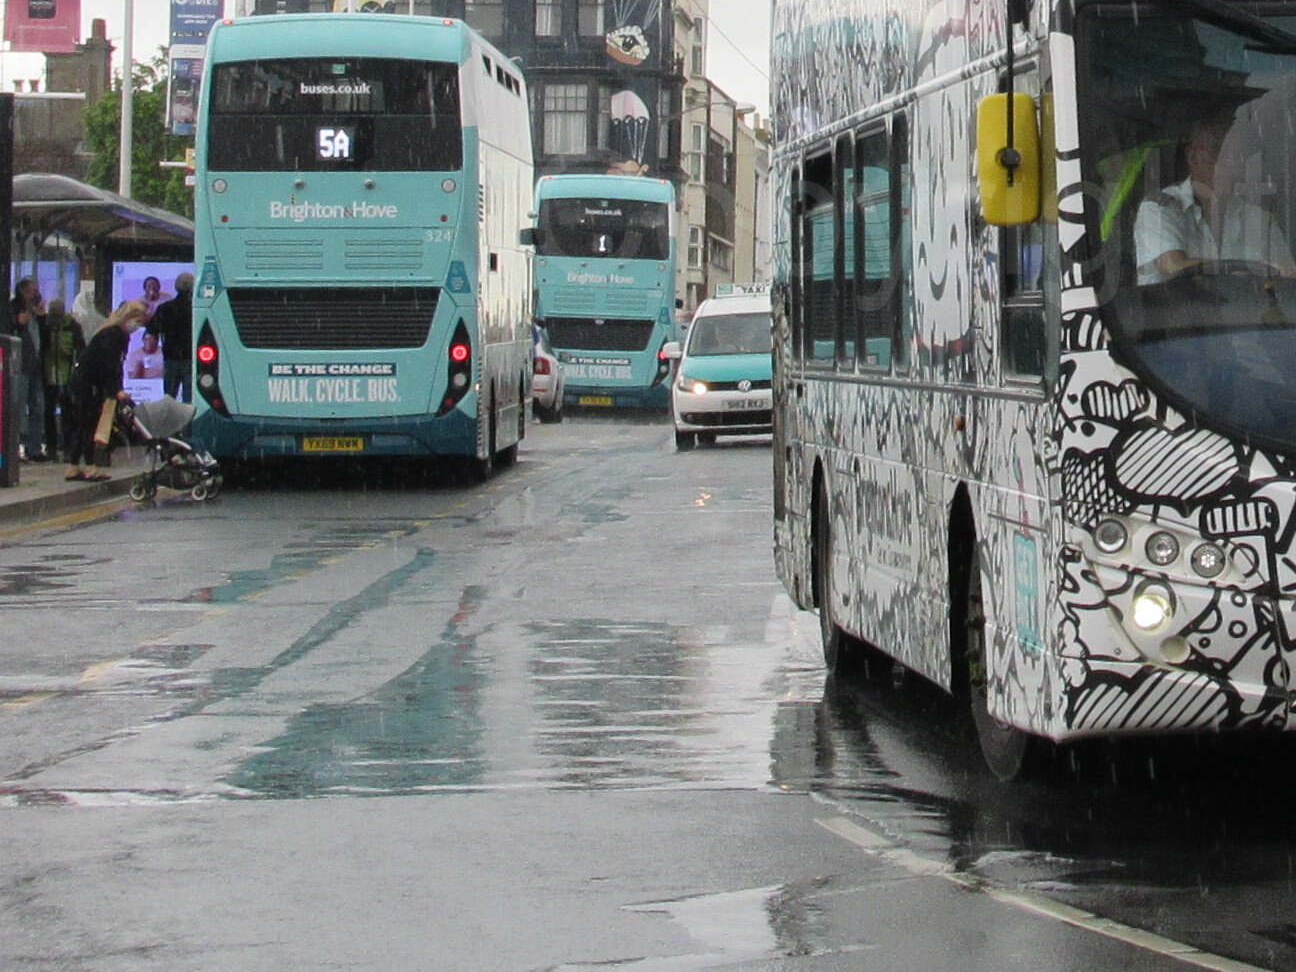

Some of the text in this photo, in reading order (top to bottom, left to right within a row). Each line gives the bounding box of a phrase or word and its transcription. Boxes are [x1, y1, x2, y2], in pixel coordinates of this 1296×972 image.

[300, 82, 371, 96] buses.co.uk
[319, 129, 351, 158] 5A
[270, 201, 345, 222] Brighton
[353, 201, 398, 218] Hove
[425, 230, 452, 242] 324
[598, 235, 606, 252] 1
[741, 286, 766, 294] TAXI
[271, 365, 393, 374] BE THE CHANGE
[268, 377, 401, 403] WALK. CYCLE. BUS.
